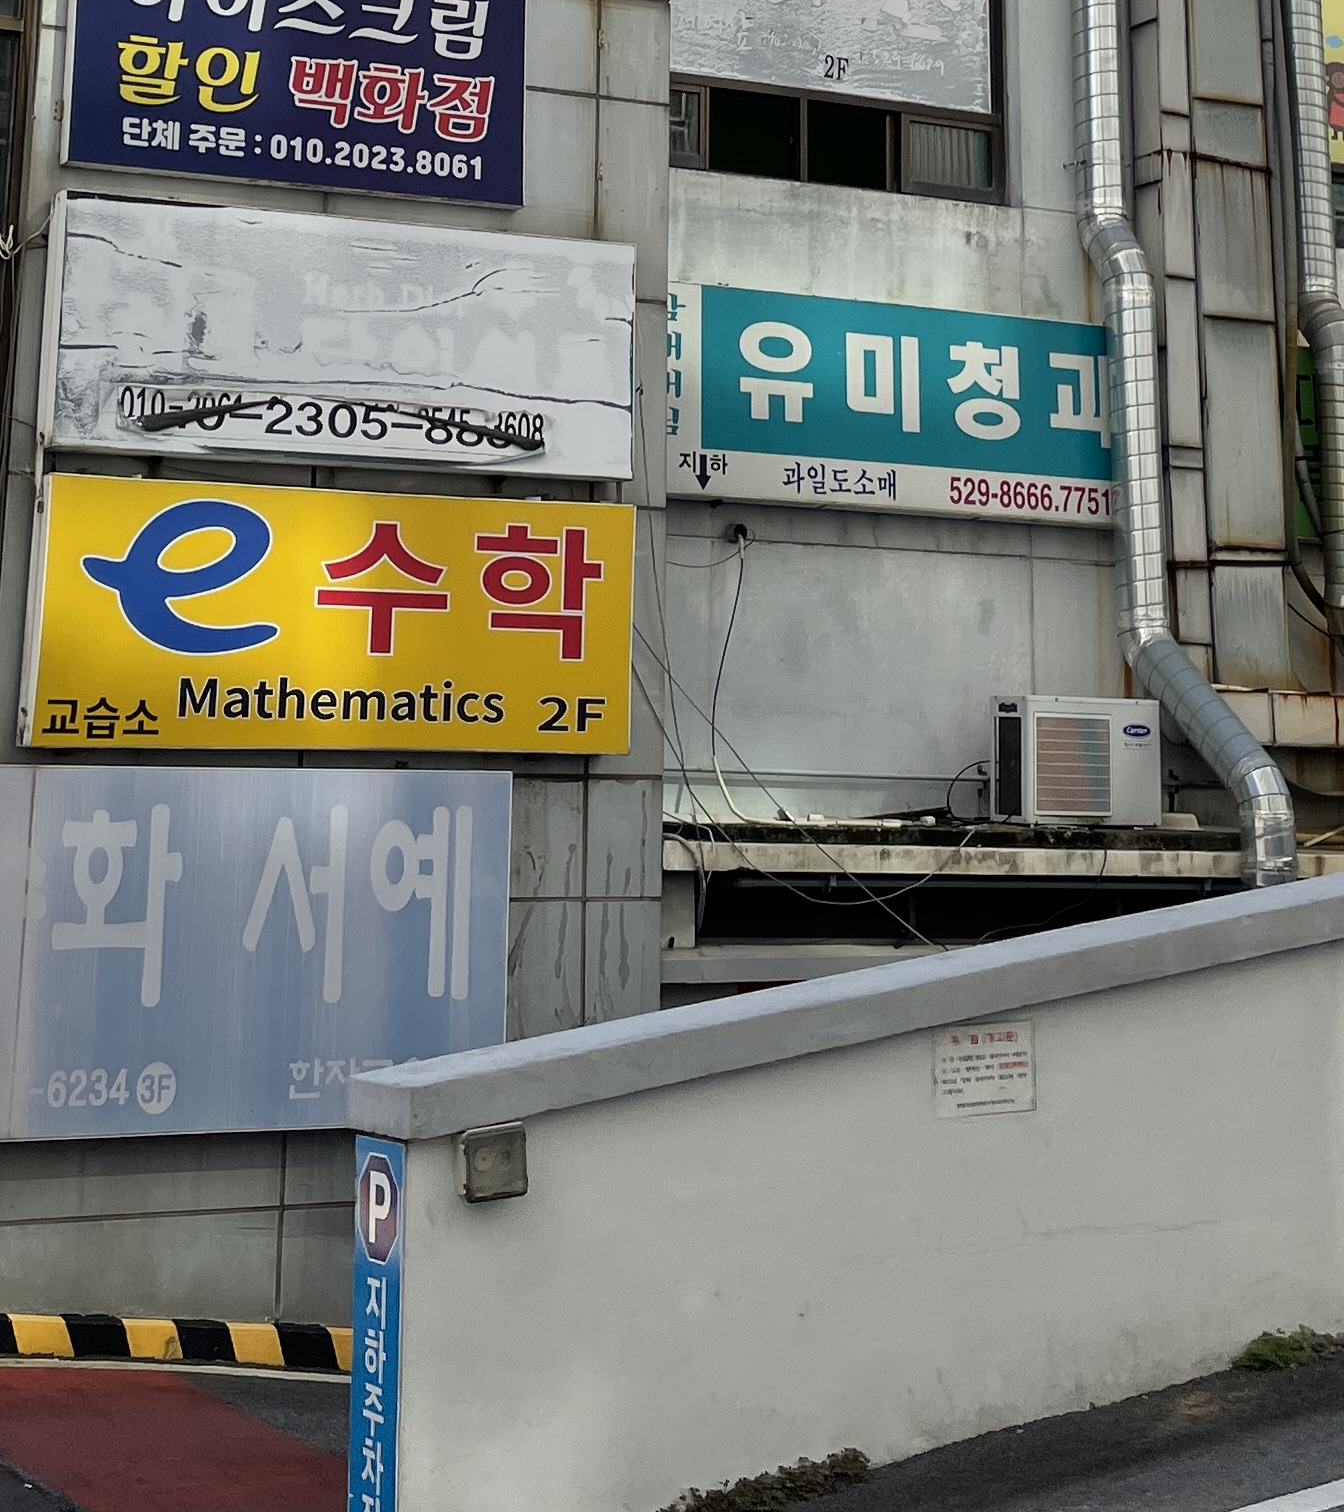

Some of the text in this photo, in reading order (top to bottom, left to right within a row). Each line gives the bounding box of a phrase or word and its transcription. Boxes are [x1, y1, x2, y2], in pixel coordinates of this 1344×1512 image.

[117, 34, 496, 144] 할인 백화점
[823, 54, 850, 81] 2F
[122, 116, 181, 151] 단체
[269, 132, 483, 182] 010.2023.8061
[738, 320, 1112, 450] 유미청과
[678, 450, 729, 476] 지하
[782, 460, 897, 501] 과일도소매
[313, 519, 606, 663] 수학
[41, 675, 608, 739] 교습소 Mathematics 2F
[243, 803, 474, 1005] 서예
[139, 1072, 173, 1104] 3F
[367, 1169, 393, 1245] P
